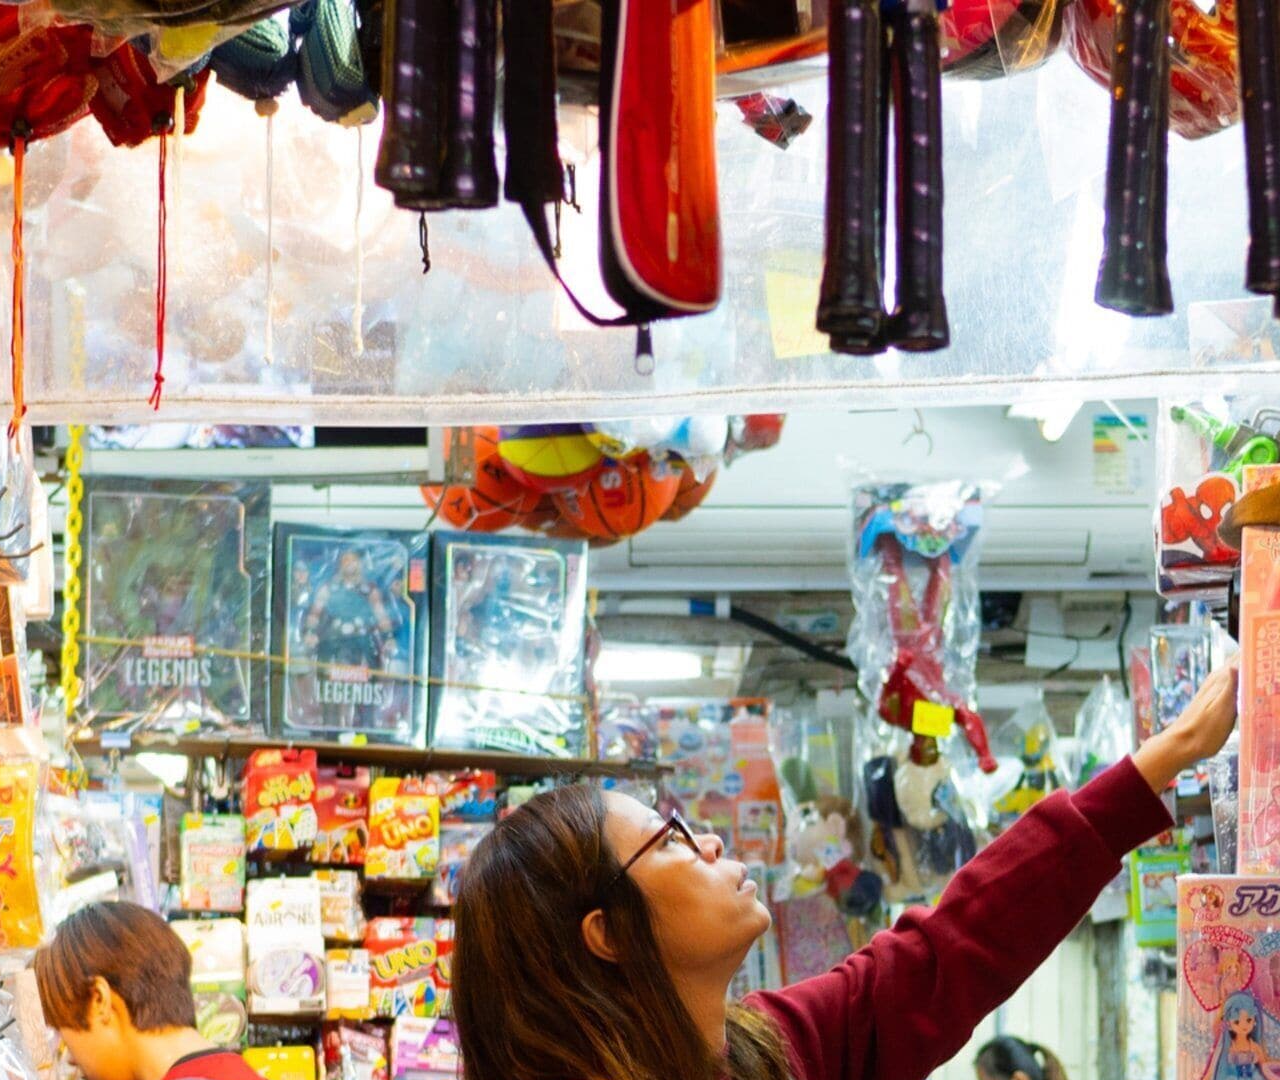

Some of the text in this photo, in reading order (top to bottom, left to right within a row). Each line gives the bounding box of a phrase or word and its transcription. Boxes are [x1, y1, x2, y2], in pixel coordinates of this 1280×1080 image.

[124, 658, 212, 688] LEGENDS
[316, 680, 384, 705] LEGENDS
[380, 816, 432, 850] UNO
[372, 941, 437, 980] UNO
